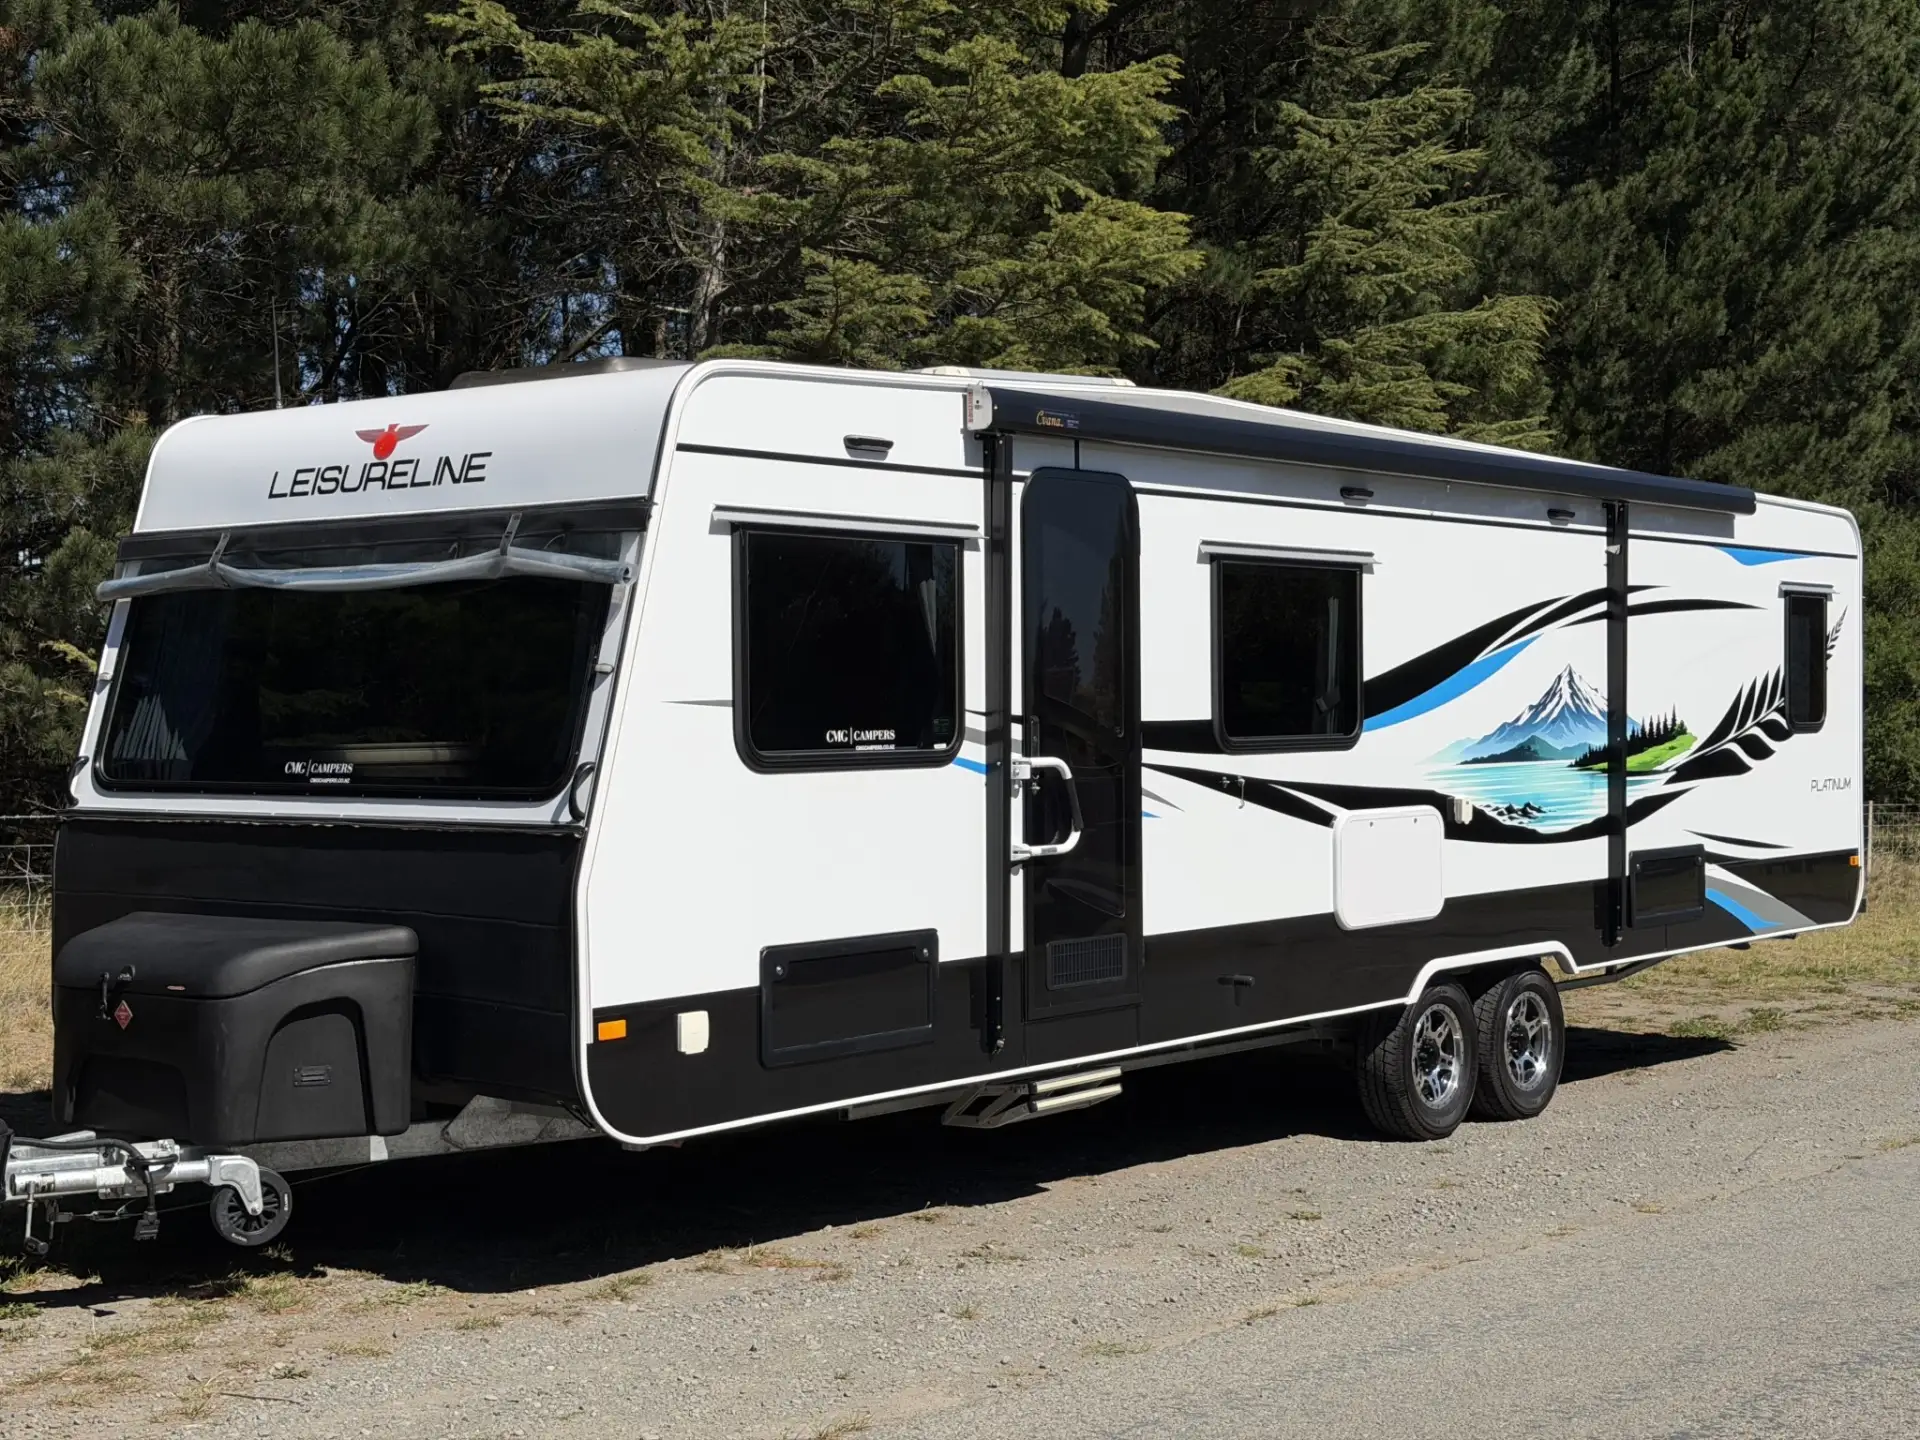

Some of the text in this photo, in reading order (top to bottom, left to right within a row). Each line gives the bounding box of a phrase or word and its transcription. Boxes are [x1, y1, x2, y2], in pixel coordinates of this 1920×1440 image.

[268, 451, 493, 499] LEISURELINE
[825, 729, 895, 743] CMG CAMPERS
[285, 761, 354, 774] CMG CAMPERS
[1811, 777, 1851, 792] PLATINUM
